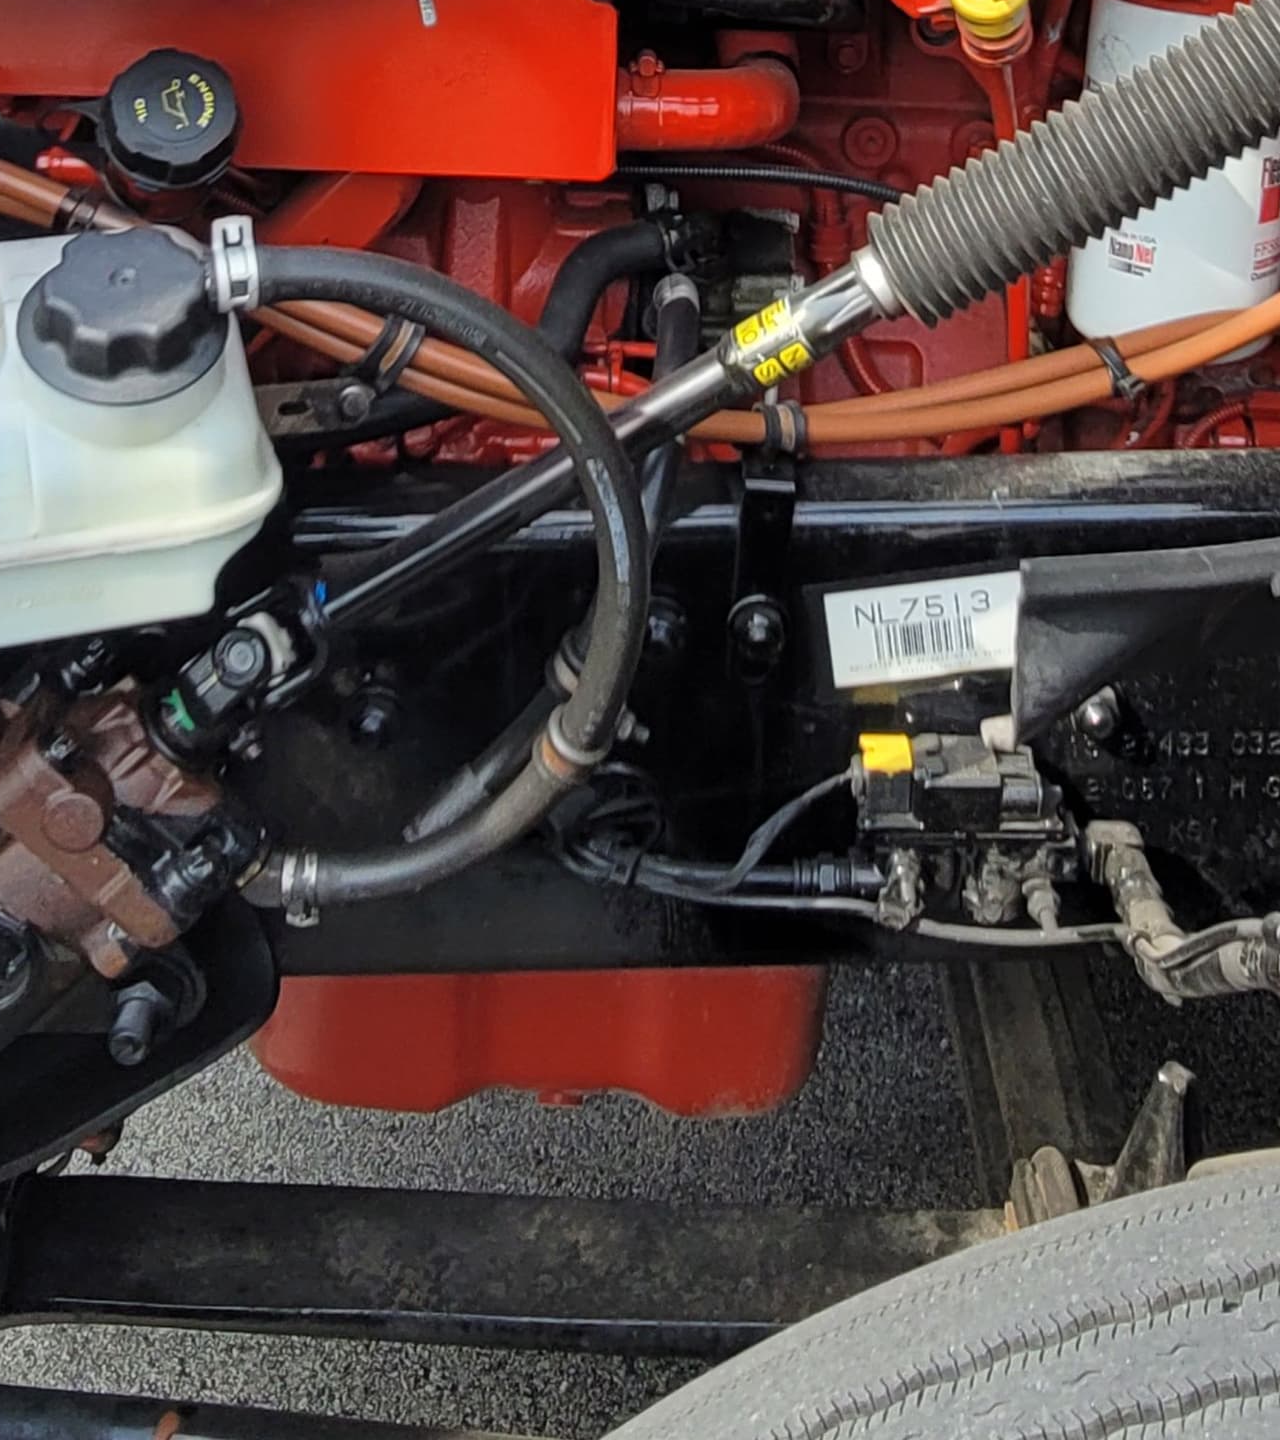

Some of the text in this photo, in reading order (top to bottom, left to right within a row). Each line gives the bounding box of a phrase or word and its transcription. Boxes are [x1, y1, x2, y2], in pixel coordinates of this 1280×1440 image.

[133, 98, 149, 123] OIL
[187, 73, 215, 128] ENGINE
[853, 589, 991, 629] NL7513
